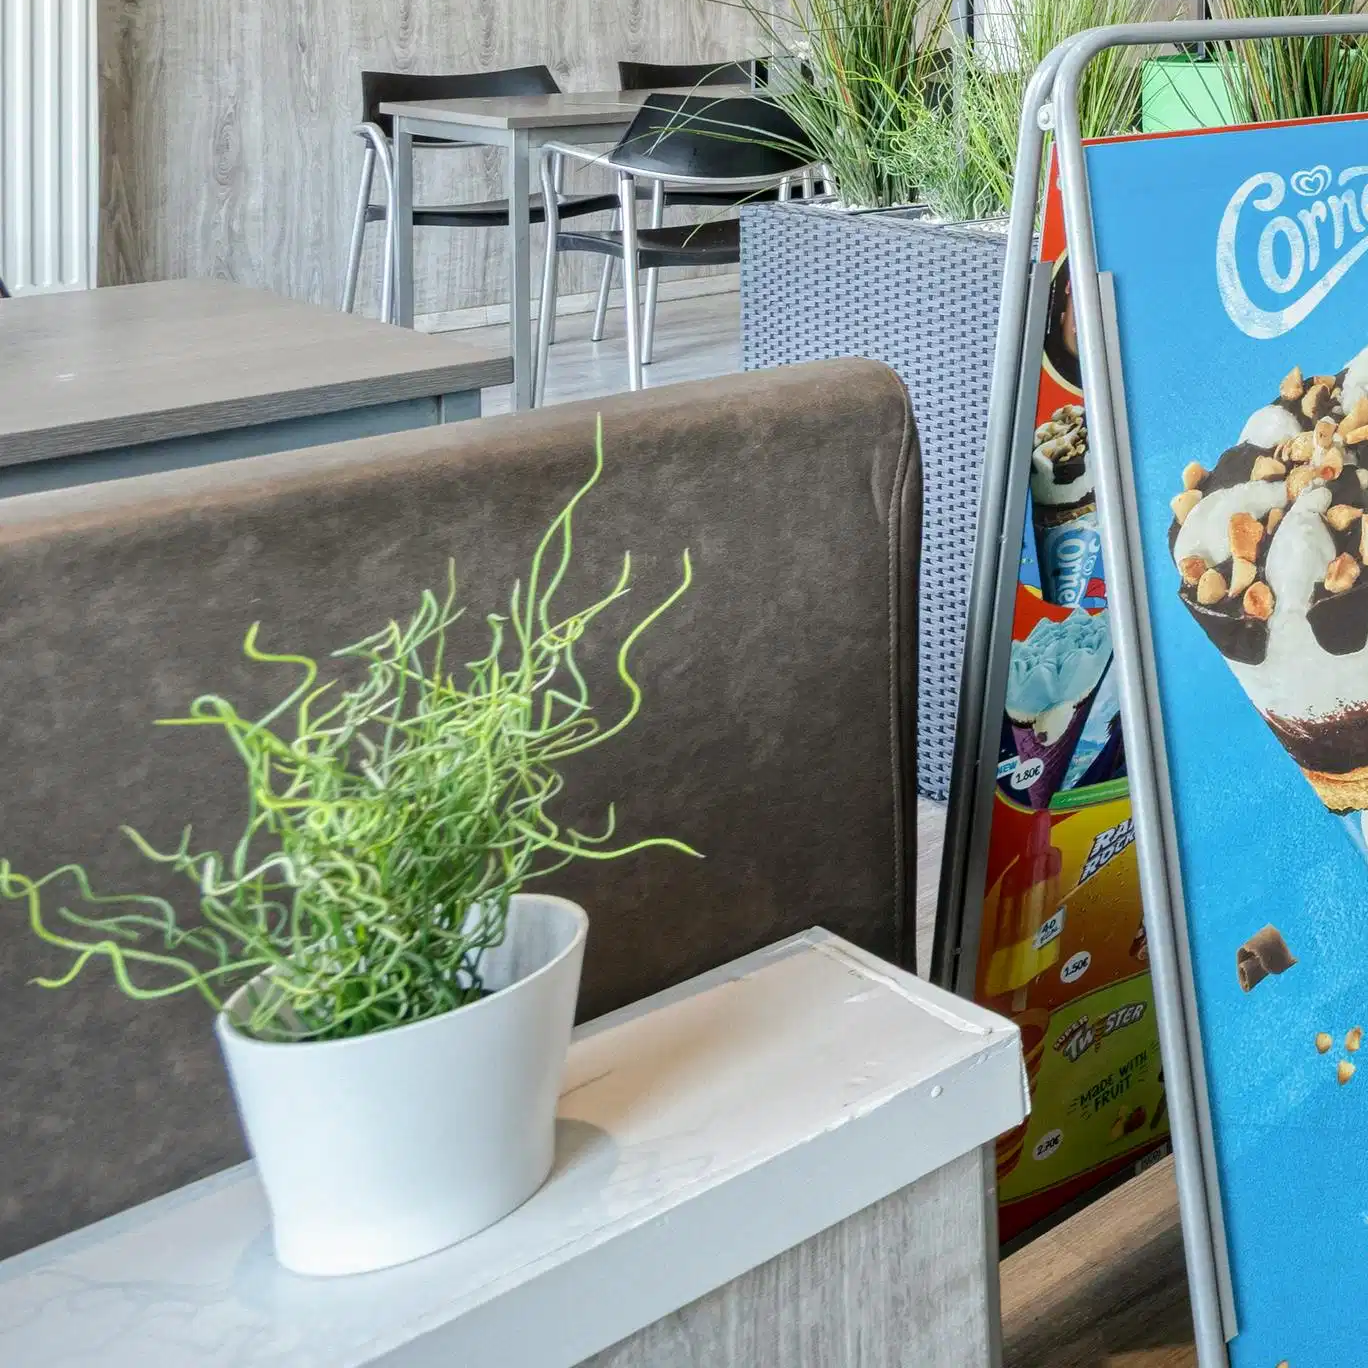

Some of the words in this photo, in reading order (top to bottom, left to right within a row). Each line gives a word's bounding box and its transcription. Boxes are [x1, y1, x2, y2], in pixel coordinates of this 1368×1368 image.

[1015, 765, 1041, 784] 1.80€
[1079, 830, 1137, 886] ROCK
[1064, 956, 1089, 977] 1.50€
[1119, 1049, 1149, 1077] WITH
